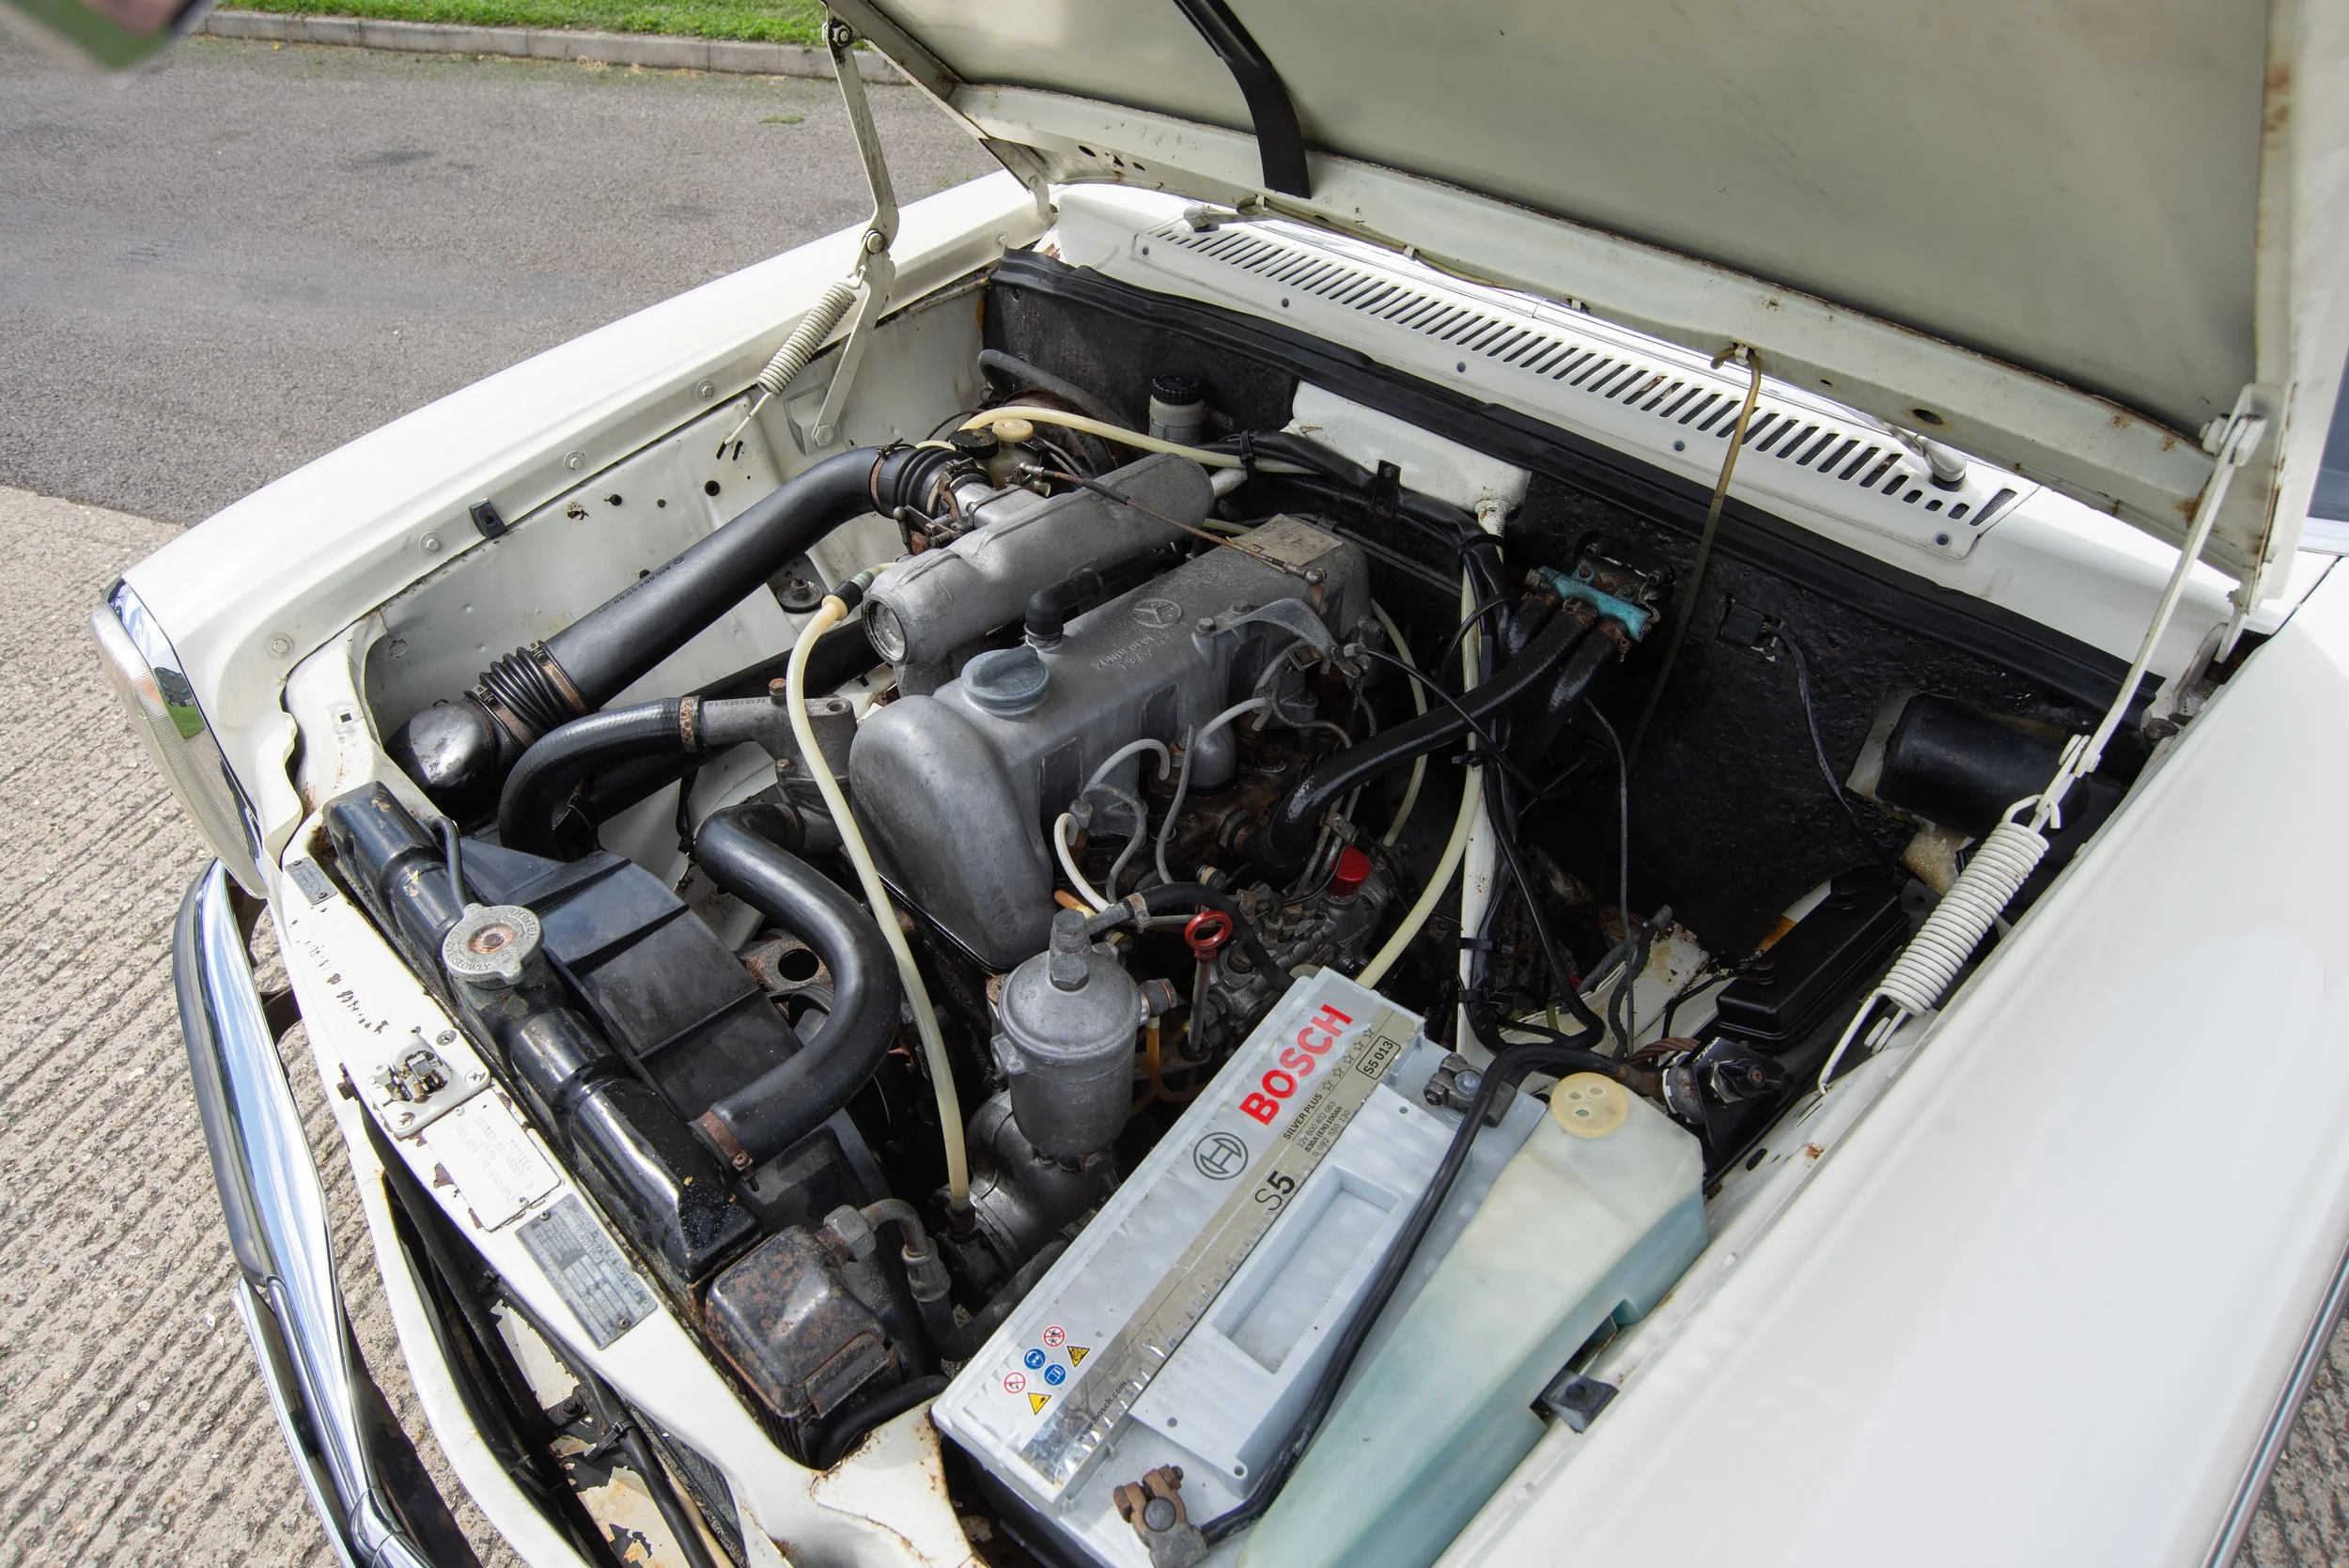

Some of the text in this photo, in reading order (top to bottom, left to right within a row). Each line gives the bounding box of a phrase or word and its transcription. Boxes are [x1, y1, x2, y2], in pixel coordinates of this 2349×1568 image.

[510, 908, 537, 939] TIGHTEN
[445, 925, 490, 971] REOVE SLOWLY
[1237, 1003, 1353, 1126] BOSCH
[1363, 1041, 1393, 1075] S5 013
[1283, 1093, 1323, 1140] SILVER PLUS
[1297, 1135, 1308, 1147] 12V
[1307, 1124, 1317, 1136] 600
[1316, 1112, 1327, 1125] 402
[1304, 1106, 1344, 1153] 830A (EN) 100Ah
[1317, 1137, 1330, 1151] 092
[1339, 1110, 1351, 1123] 130
[1254, 1171, 1296, 1211] S5
[1076, 1381, 1128, 1442] www.bosch.com
